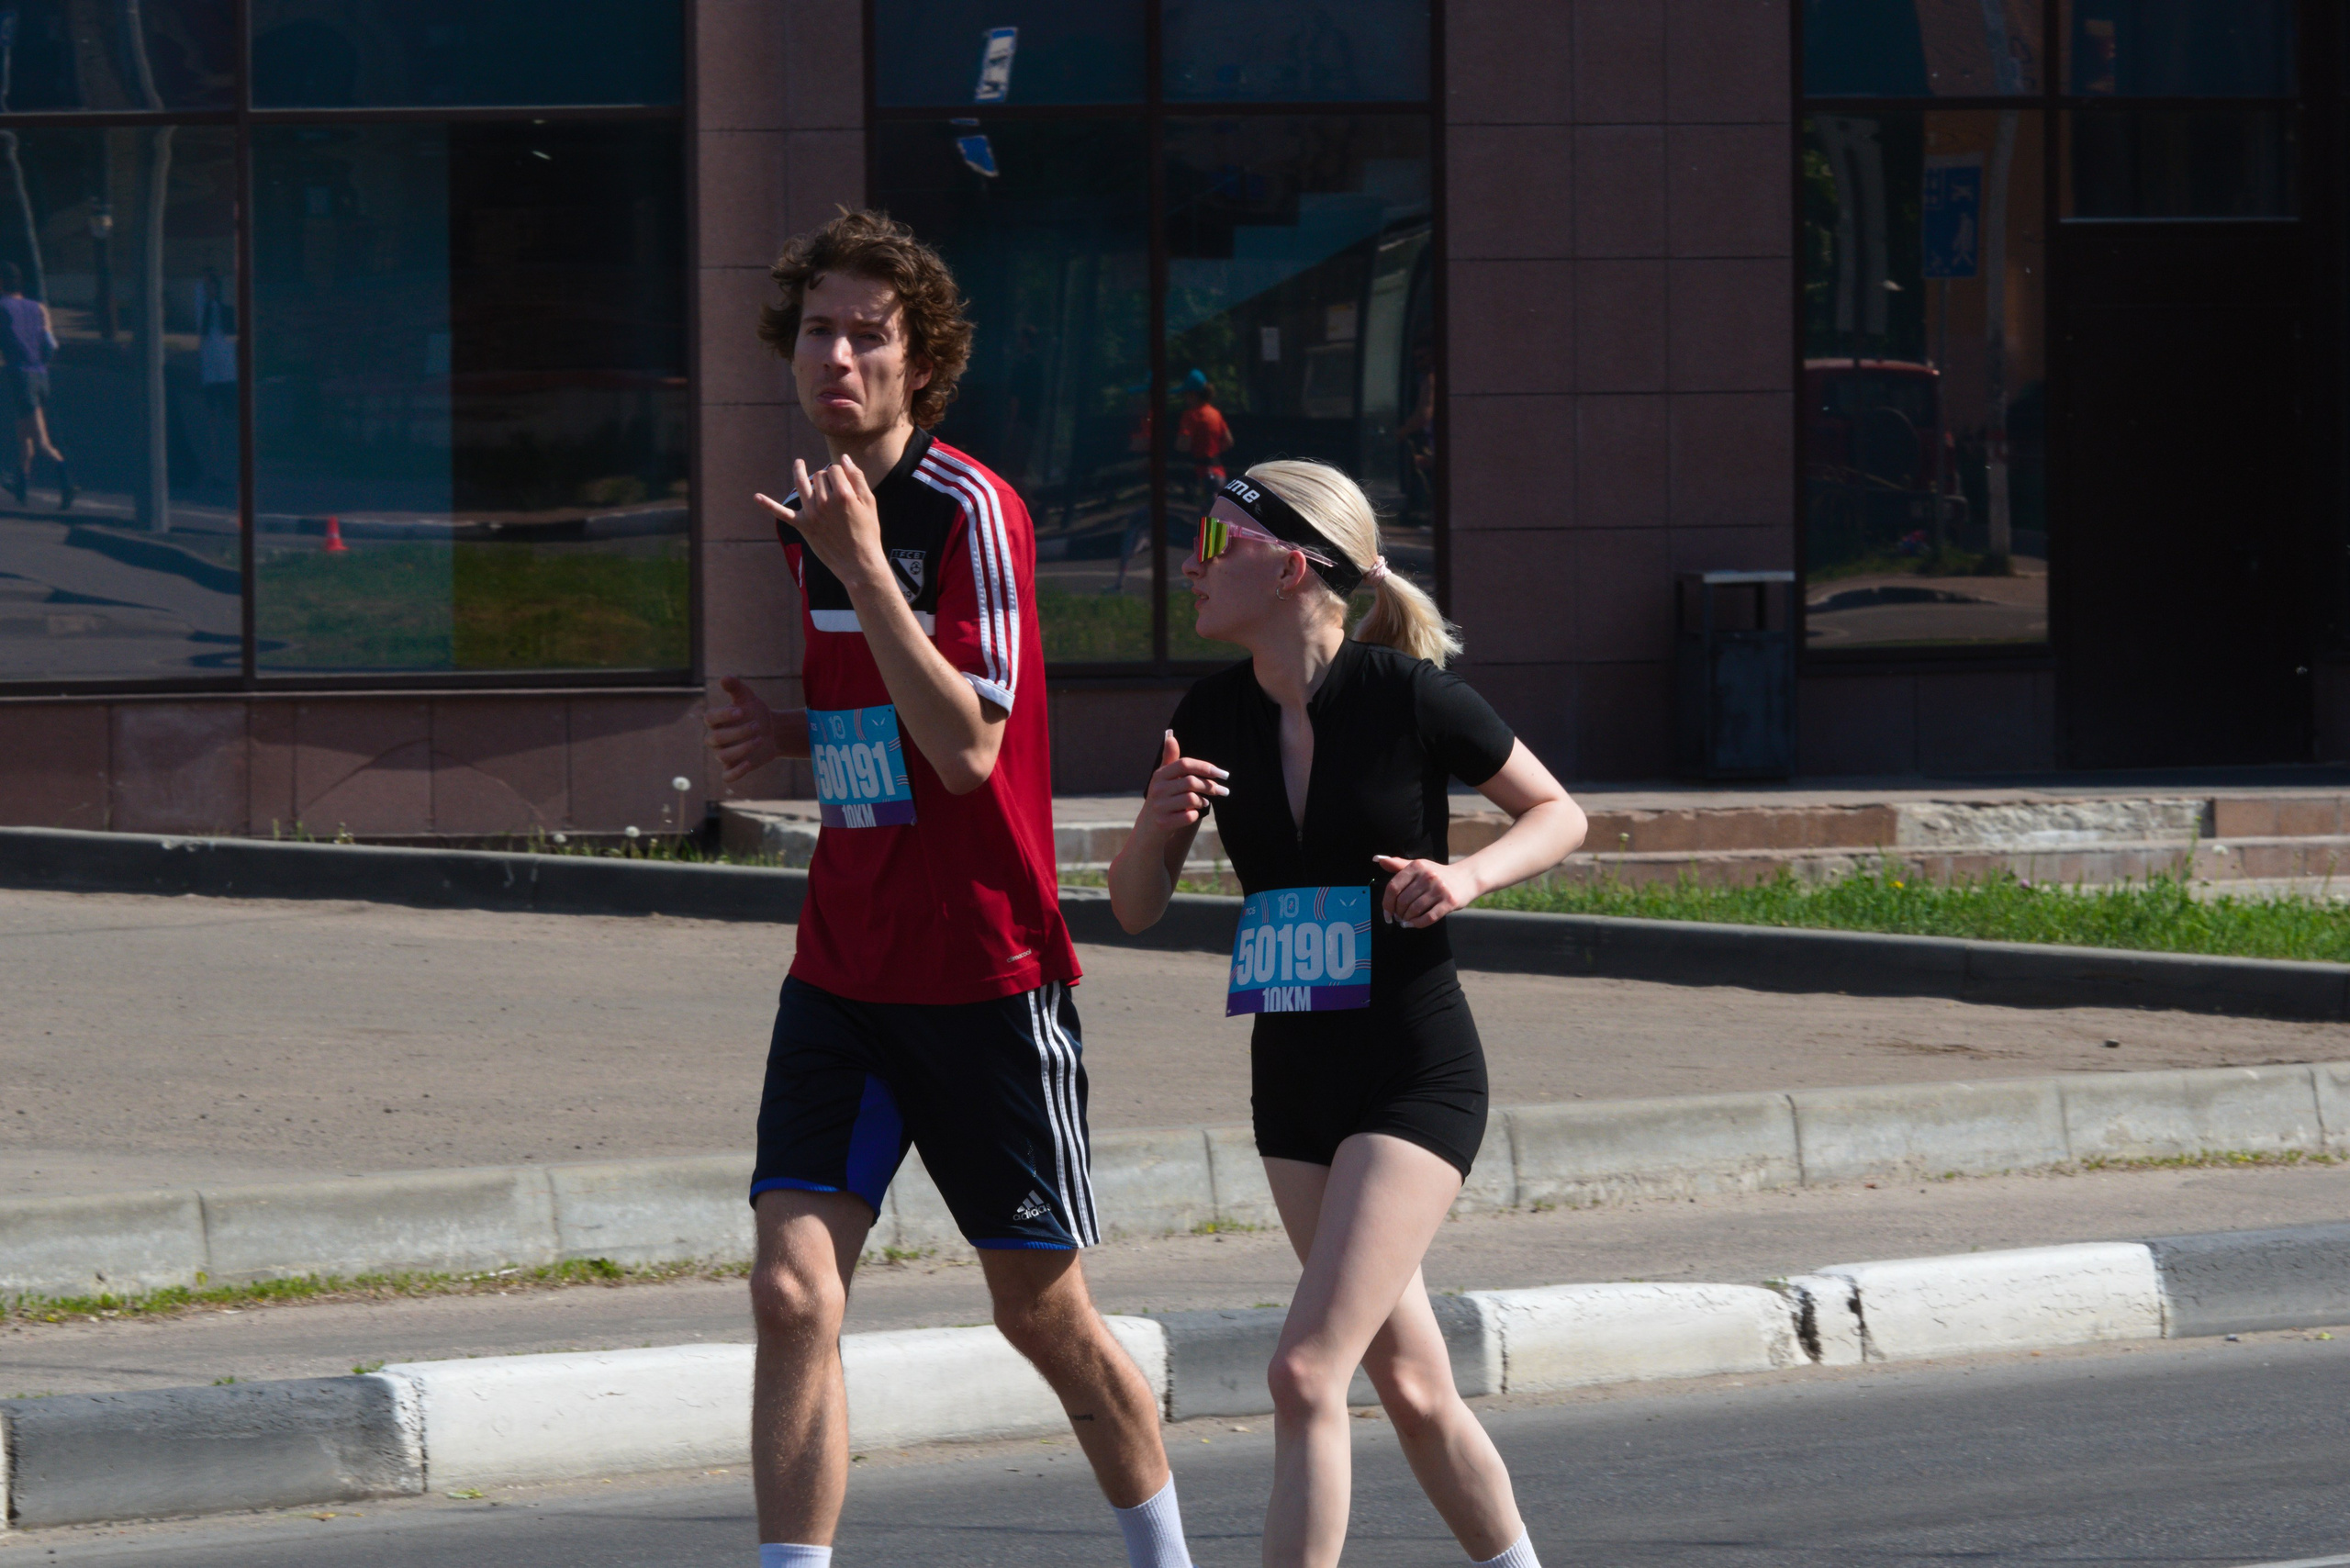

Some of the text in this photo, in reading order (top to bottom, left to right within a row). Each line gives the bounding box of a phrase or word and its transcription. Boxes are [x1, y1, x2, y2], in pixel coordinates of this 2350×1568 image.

[814, 741, 896, 801] 50191
[842, 803, 877, 828] 10KM
[1277, 892, 1299, 918] 10
[1237, 922, 1356, 986] 50190
[1262, 986, 1312, 1013] 10KM
[1013, 1203, 1051, 1221] adidas
